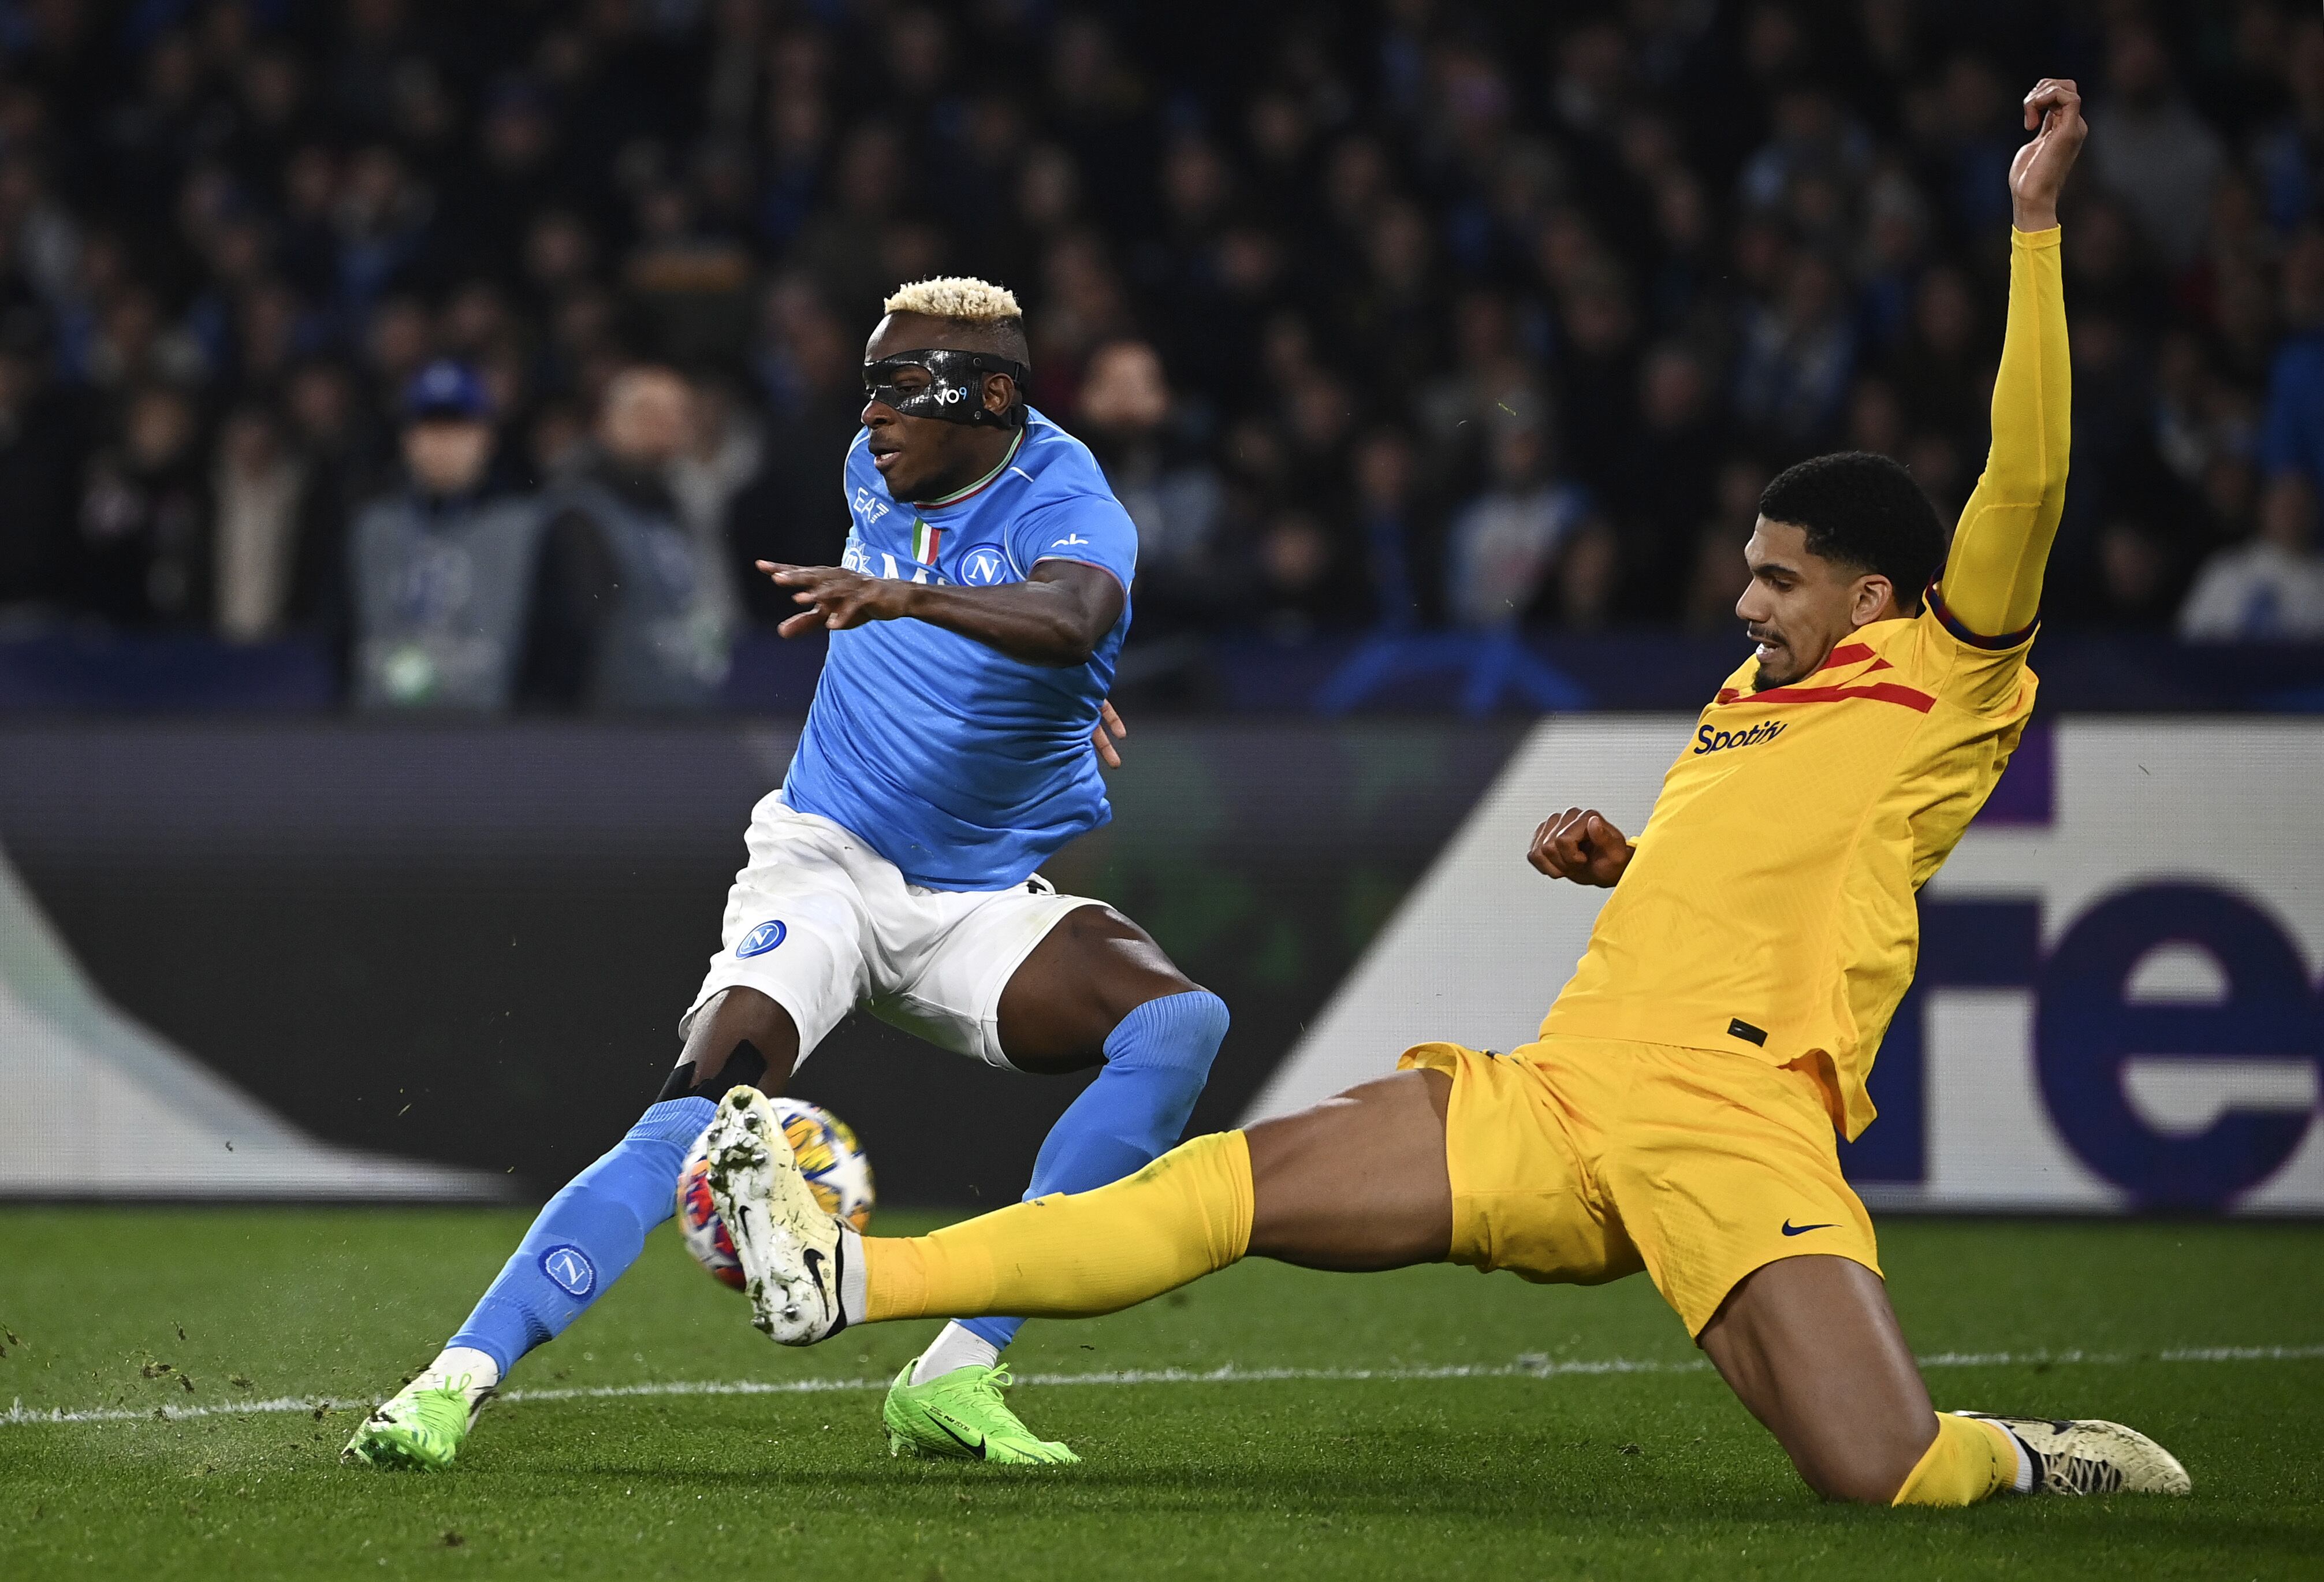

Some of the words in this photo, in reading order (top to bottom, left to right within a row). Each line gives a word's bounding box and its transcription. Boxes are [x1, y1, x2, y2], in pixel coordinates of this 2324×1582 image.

[853, 487, 889, 524] EA7
[967, 554, 1000, 583] N
[1693, 720, 1789, 755] Spotify
[743, 928, 773, 950] N
[552, 1253, 586, 1285] N
